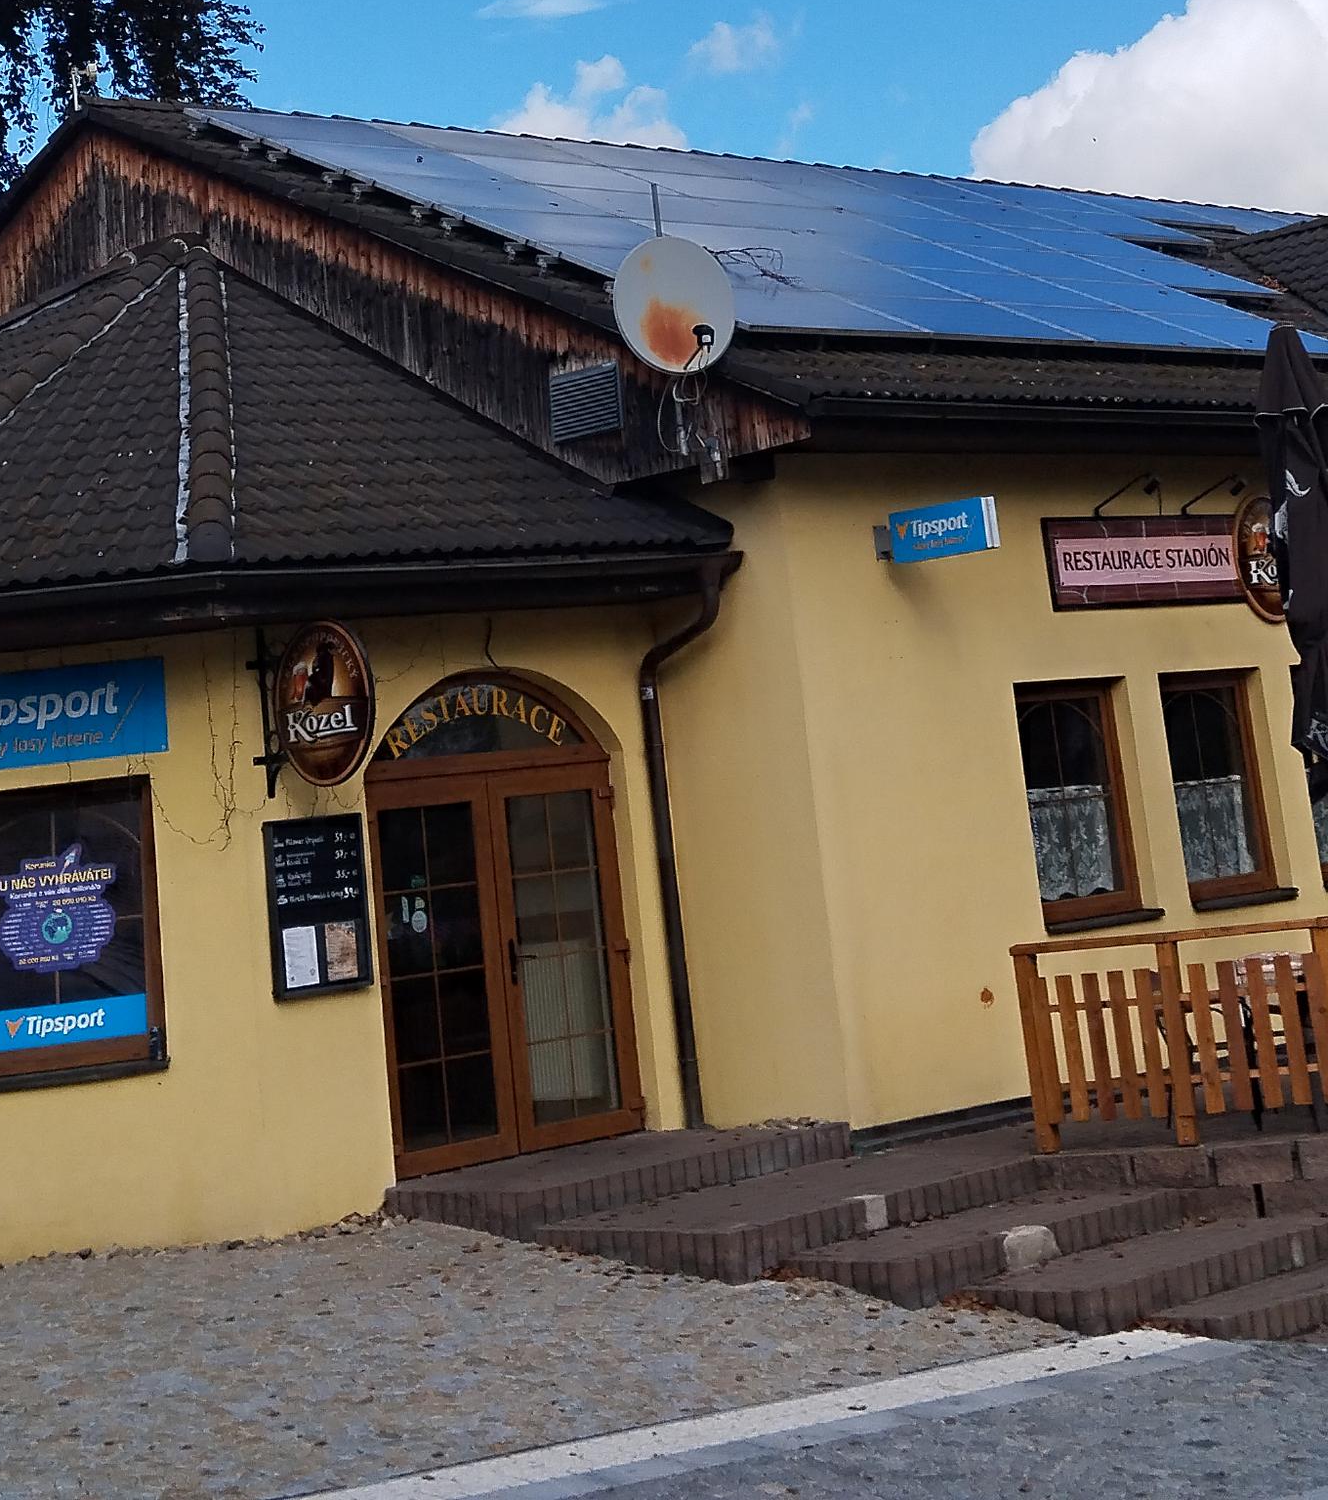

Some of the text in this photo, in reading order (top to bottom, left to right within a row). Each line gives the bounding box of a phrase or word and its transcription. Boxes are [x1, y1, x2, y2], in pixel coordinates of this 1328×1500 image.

[910, 512, 969, 539] Tipsport
[1063, 543, 1231, 572] RESTAURACE STADIÓN
[286, 704, 358, 743] Kozel
[385, 685, 567, 760] RESTAURACE
[0, 867, 112, 892] U NÁS VYHRÁVÁTE!
[26, 1008, 106, 1038] Tipsport
